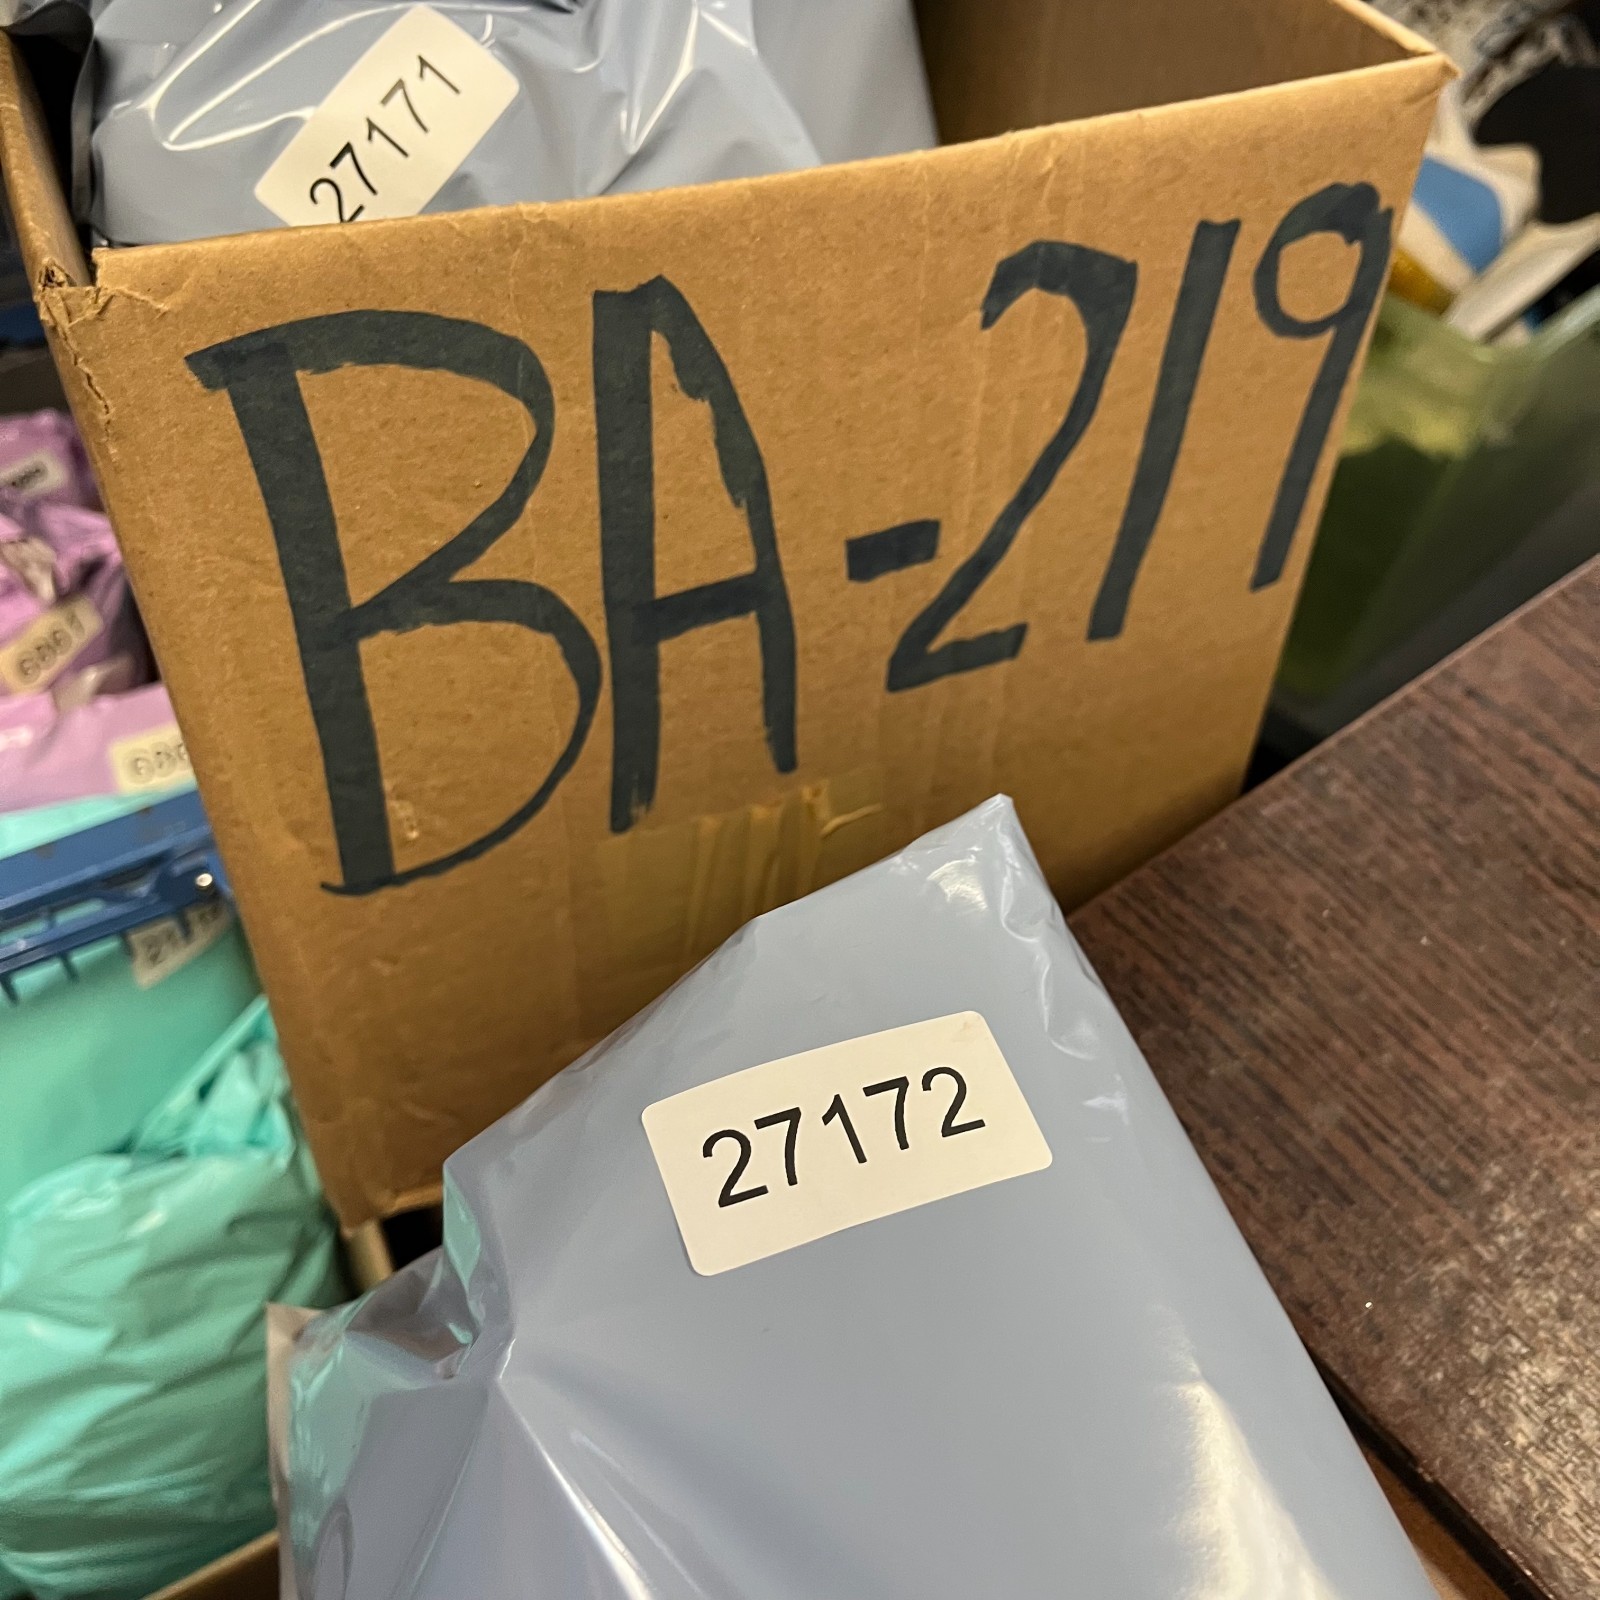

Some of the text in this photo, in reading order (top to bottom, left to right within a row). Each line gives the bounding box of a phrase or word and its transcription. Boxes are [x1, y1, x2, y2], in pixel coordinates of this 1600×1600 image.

[309, 54, 461, 223] 27171
[185, 182, 1393, 897] BA-219
[702, 1066, 986, 1208] 27172
